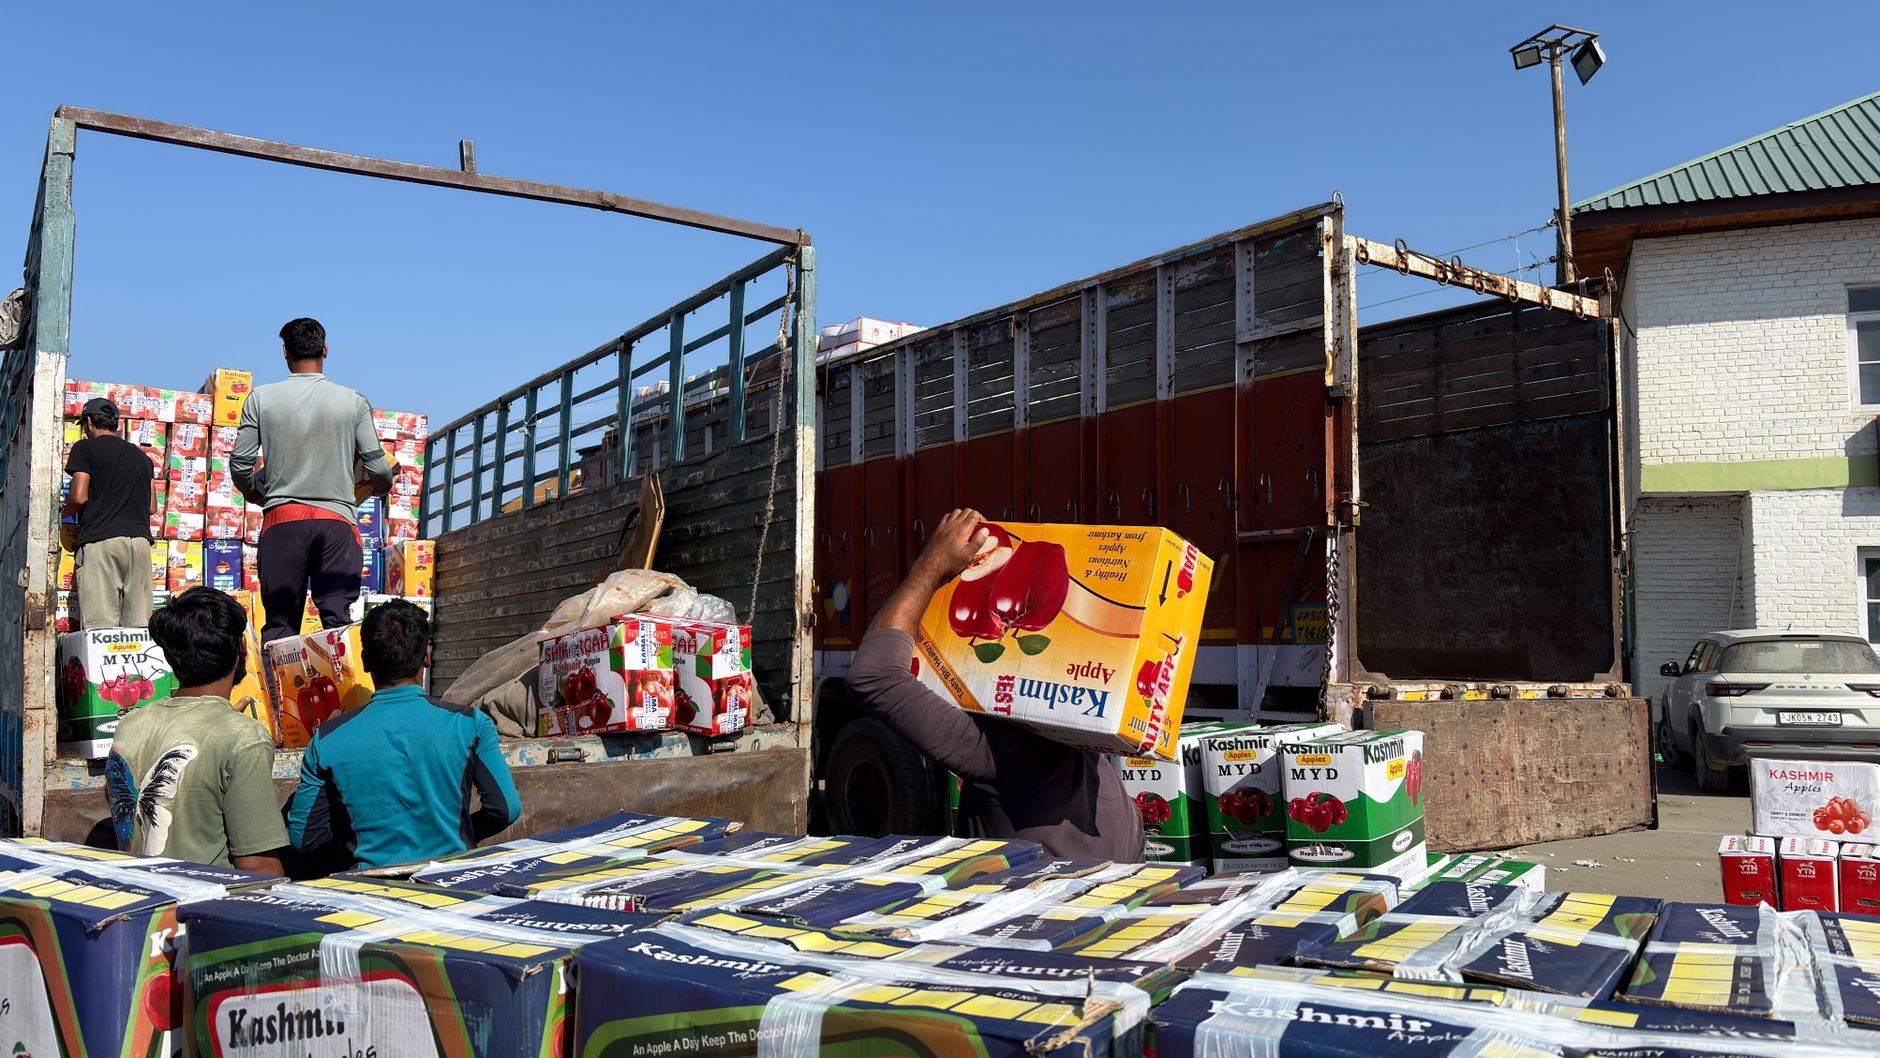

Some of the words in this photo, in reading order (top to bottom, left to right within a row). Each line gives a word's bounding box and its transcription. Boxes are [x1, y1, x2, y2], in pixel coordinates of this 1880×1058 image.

[1087, 530, 1122, 541] Kashmir
[1124, 531, 1147, 544] from
[1098, 543, 1127, 554] Apples
[1088, 556, 1130, 568] Nutritious
[1084, 569, 1093, 579] &
[1094, 568, 1128, 582] Healthy
[113, 643, 137, 651] Apples
[544, 633, 611, 664] SHIKRGAH
[274, 648, 301, 666] ashmir
[923, 641, 941, 671] Healthy
[553, 658, 581, 674] Kashmir
[940, 664, 951, 681] Bhi
[1066, 661, 1117, 685] Apple
[949, 675, 964, 700] Tasty
[1018, 677, 1111, 719] Kashm
[1786, 713, 1813, 722] JK05N
[1817, 713, 1839, 722] 2743
[1208, 736, 1270, 751] Kashmir
[1228, 752, 1252, 760] Apples
[1364, 738, 1405, 765] Kashmir
[1130, 758, 1152, 766] Apples
[1389, 764, 1404, 777] Apples
[1769, 769, 1834, 783] KASHMIR
[1782, 782, 1822, 794] Apples
[1739, 864, 1758, 872] YTN
[1796, 867, 1816, 875] YTN
[1857, 869, 1877, 878] YTN
[1695, 908, 1754, 939] Kashmir
[628, 942, 782, 974] Kashmir
[1497, 938, 1535, 980] Kashmir
[204, 973, 214, 982] An
[214, 970, 233, 982] Apple
[233, 967, 240, 976] A
[254, 961, 272, 974] Keep
[272, 957, 286, 968] The
[287, 952, 310, 964] Doctor
[995, 991, 1014, 999] LOT
[1207, 1000, 1433, 1033] Kashmir
[228, 1002, 346, 1049] Kashmir
[633, 1044, 646, 1056] An
[646, 1041, 672, 1056] Apple
[673, 1039, 682, 1051] A
[682, 1037, 700, 1052] Day
[702, 1034, 726, 1049] Keep
[728, 1030, 748, 1044] The
[749, 1026, 785, 1043] Doctor
[1597, 1049, 1666, 1058] VARIETY
